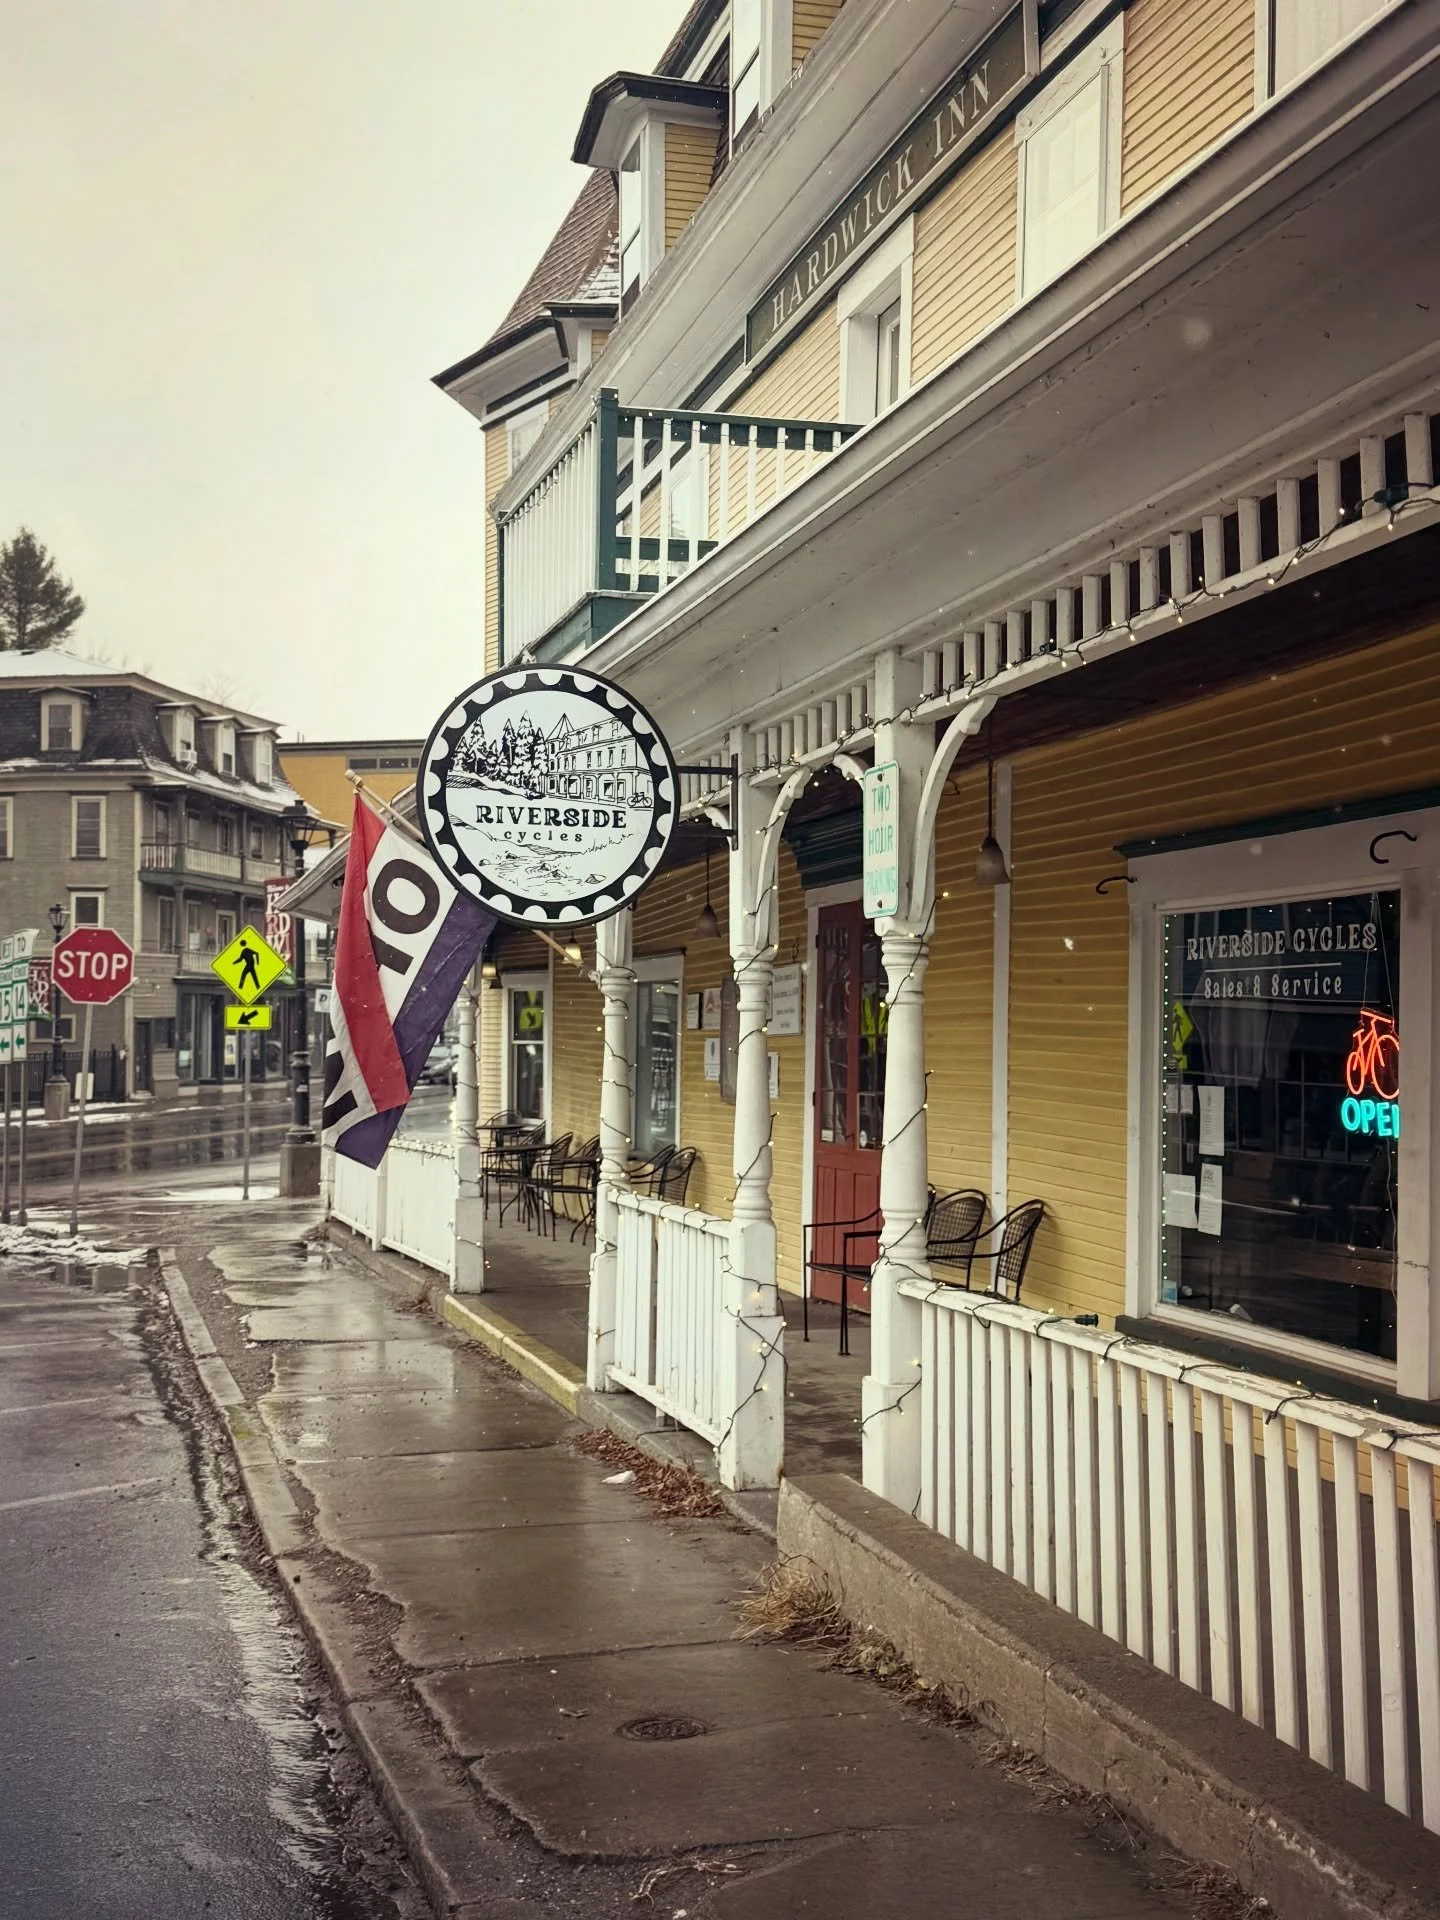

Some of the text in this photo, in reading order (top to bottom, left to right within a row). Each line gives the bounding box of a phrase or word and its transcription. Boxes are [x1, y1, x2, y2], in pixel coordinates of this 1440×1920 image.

[771, 60, 991, 332] HARDWICK INN
[871, 784, 891, 815] TWO
[476, 804, 627, 829] RIVERSIDE
[503, 829, 583, 843] cycles
[868, 825, 893, 856] HOUR
[1186, 923, 1378, 961] RIVERSIDE CYCLES
[57, 950, 129, 981] STOP
[15, 985, 25, 1017] 14
[1203, 972, 1343, 999] Sales & Service
